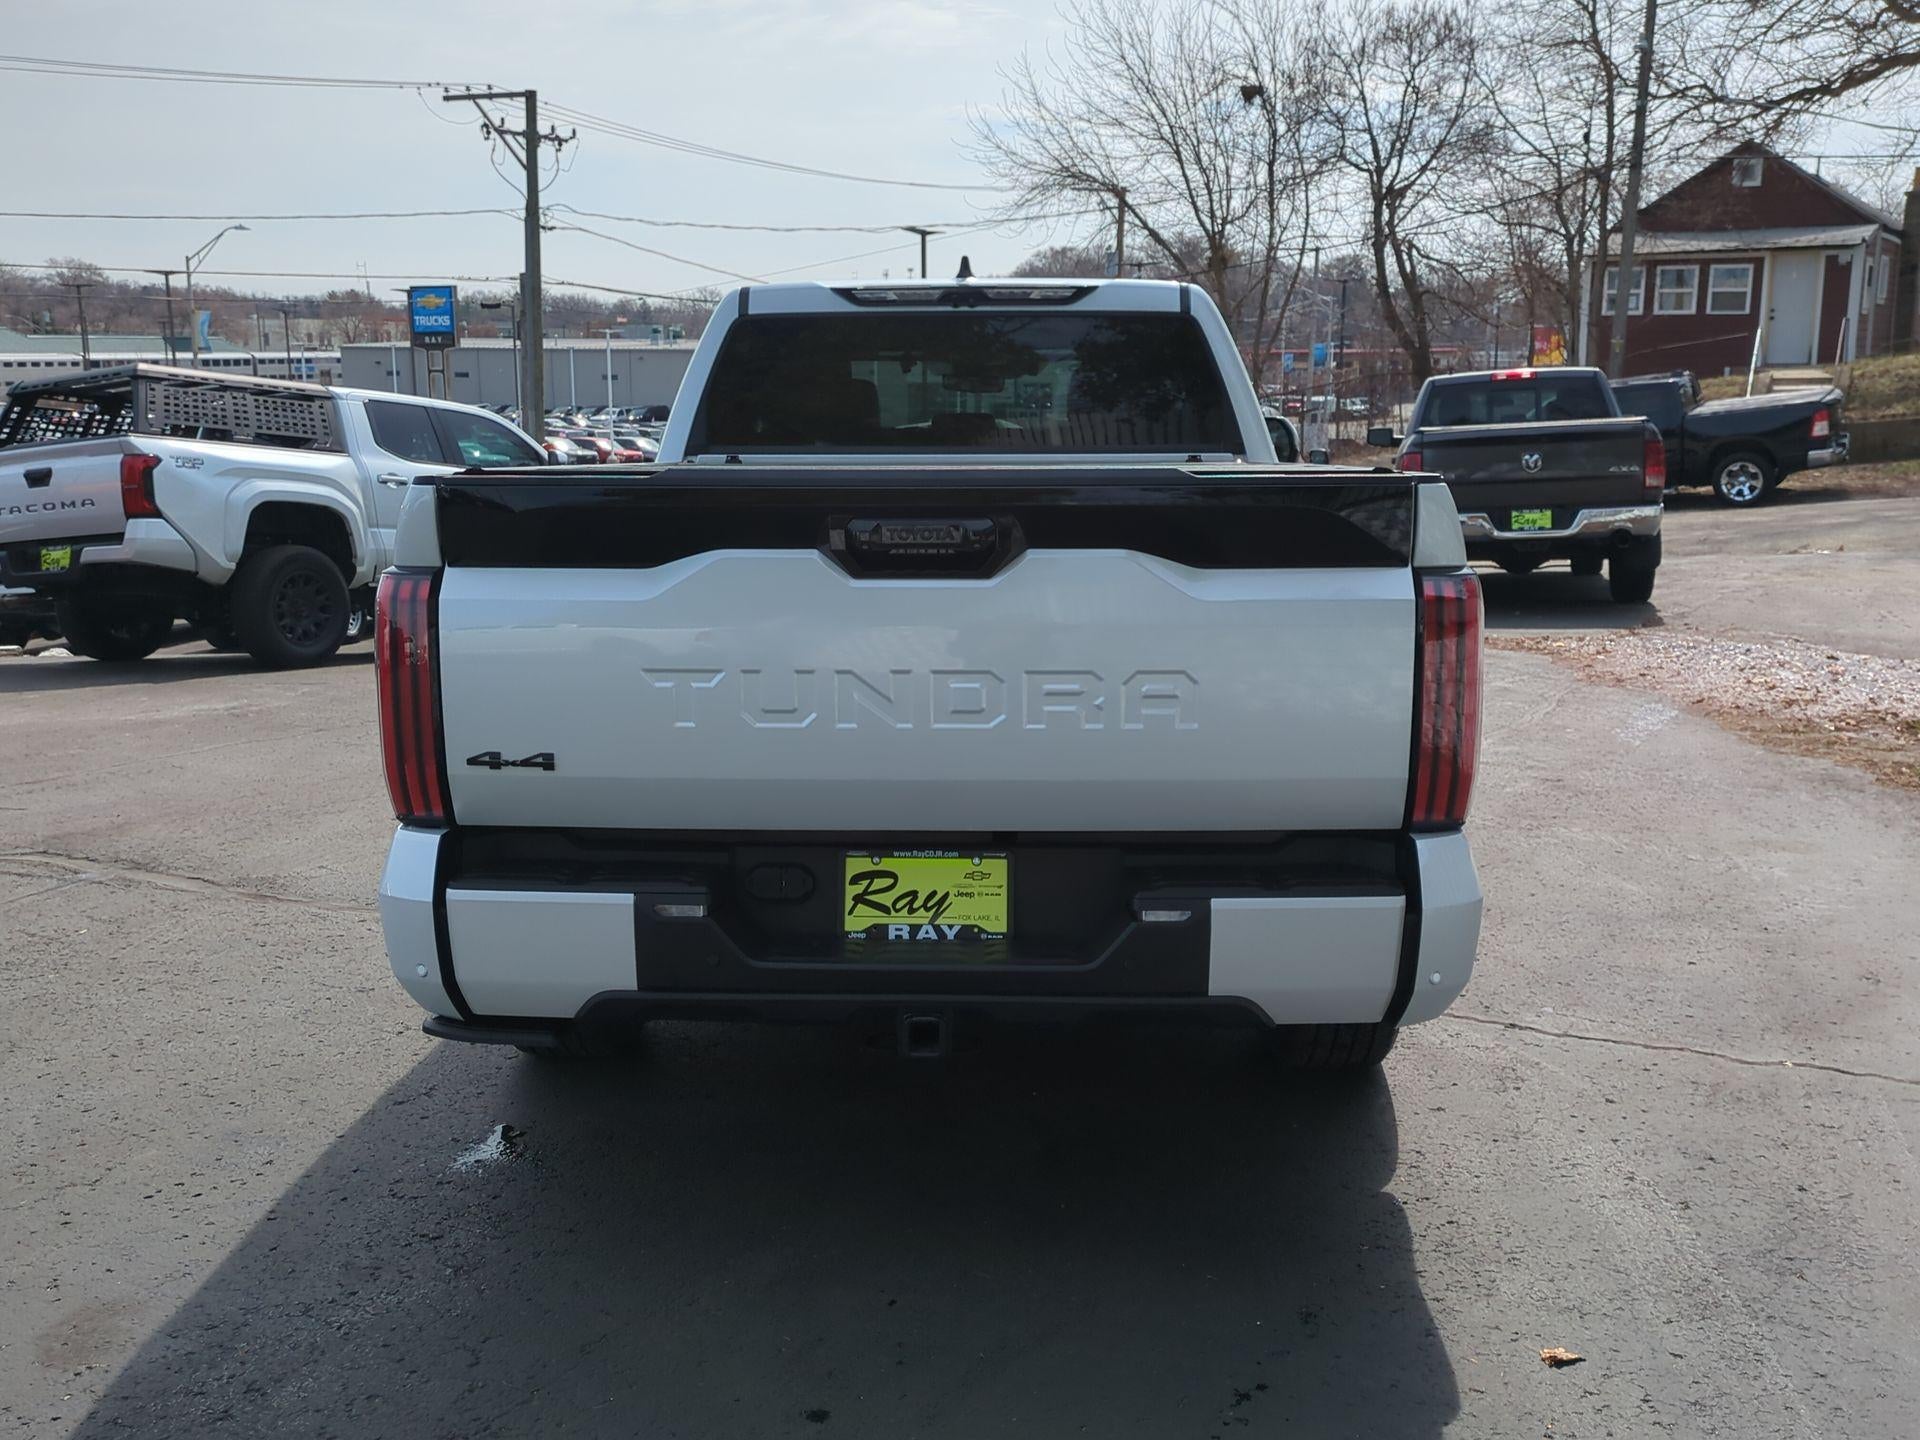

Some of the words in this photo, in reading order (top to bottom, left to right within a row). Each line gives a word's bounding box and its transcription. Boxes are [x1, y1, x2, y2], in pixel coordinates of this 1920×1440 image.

[414, 315, 450, 326] TRUCKS
[885, 527, 956, 542] TOYOTA
[641, 668, 1199, 729] TUNDRA
[848, 869, 953, 924] Ray
[953, 890, 975, 899] Jeep
[848, 931, 867, 939] Jeep
[888, 924, 962, 940] RAY
